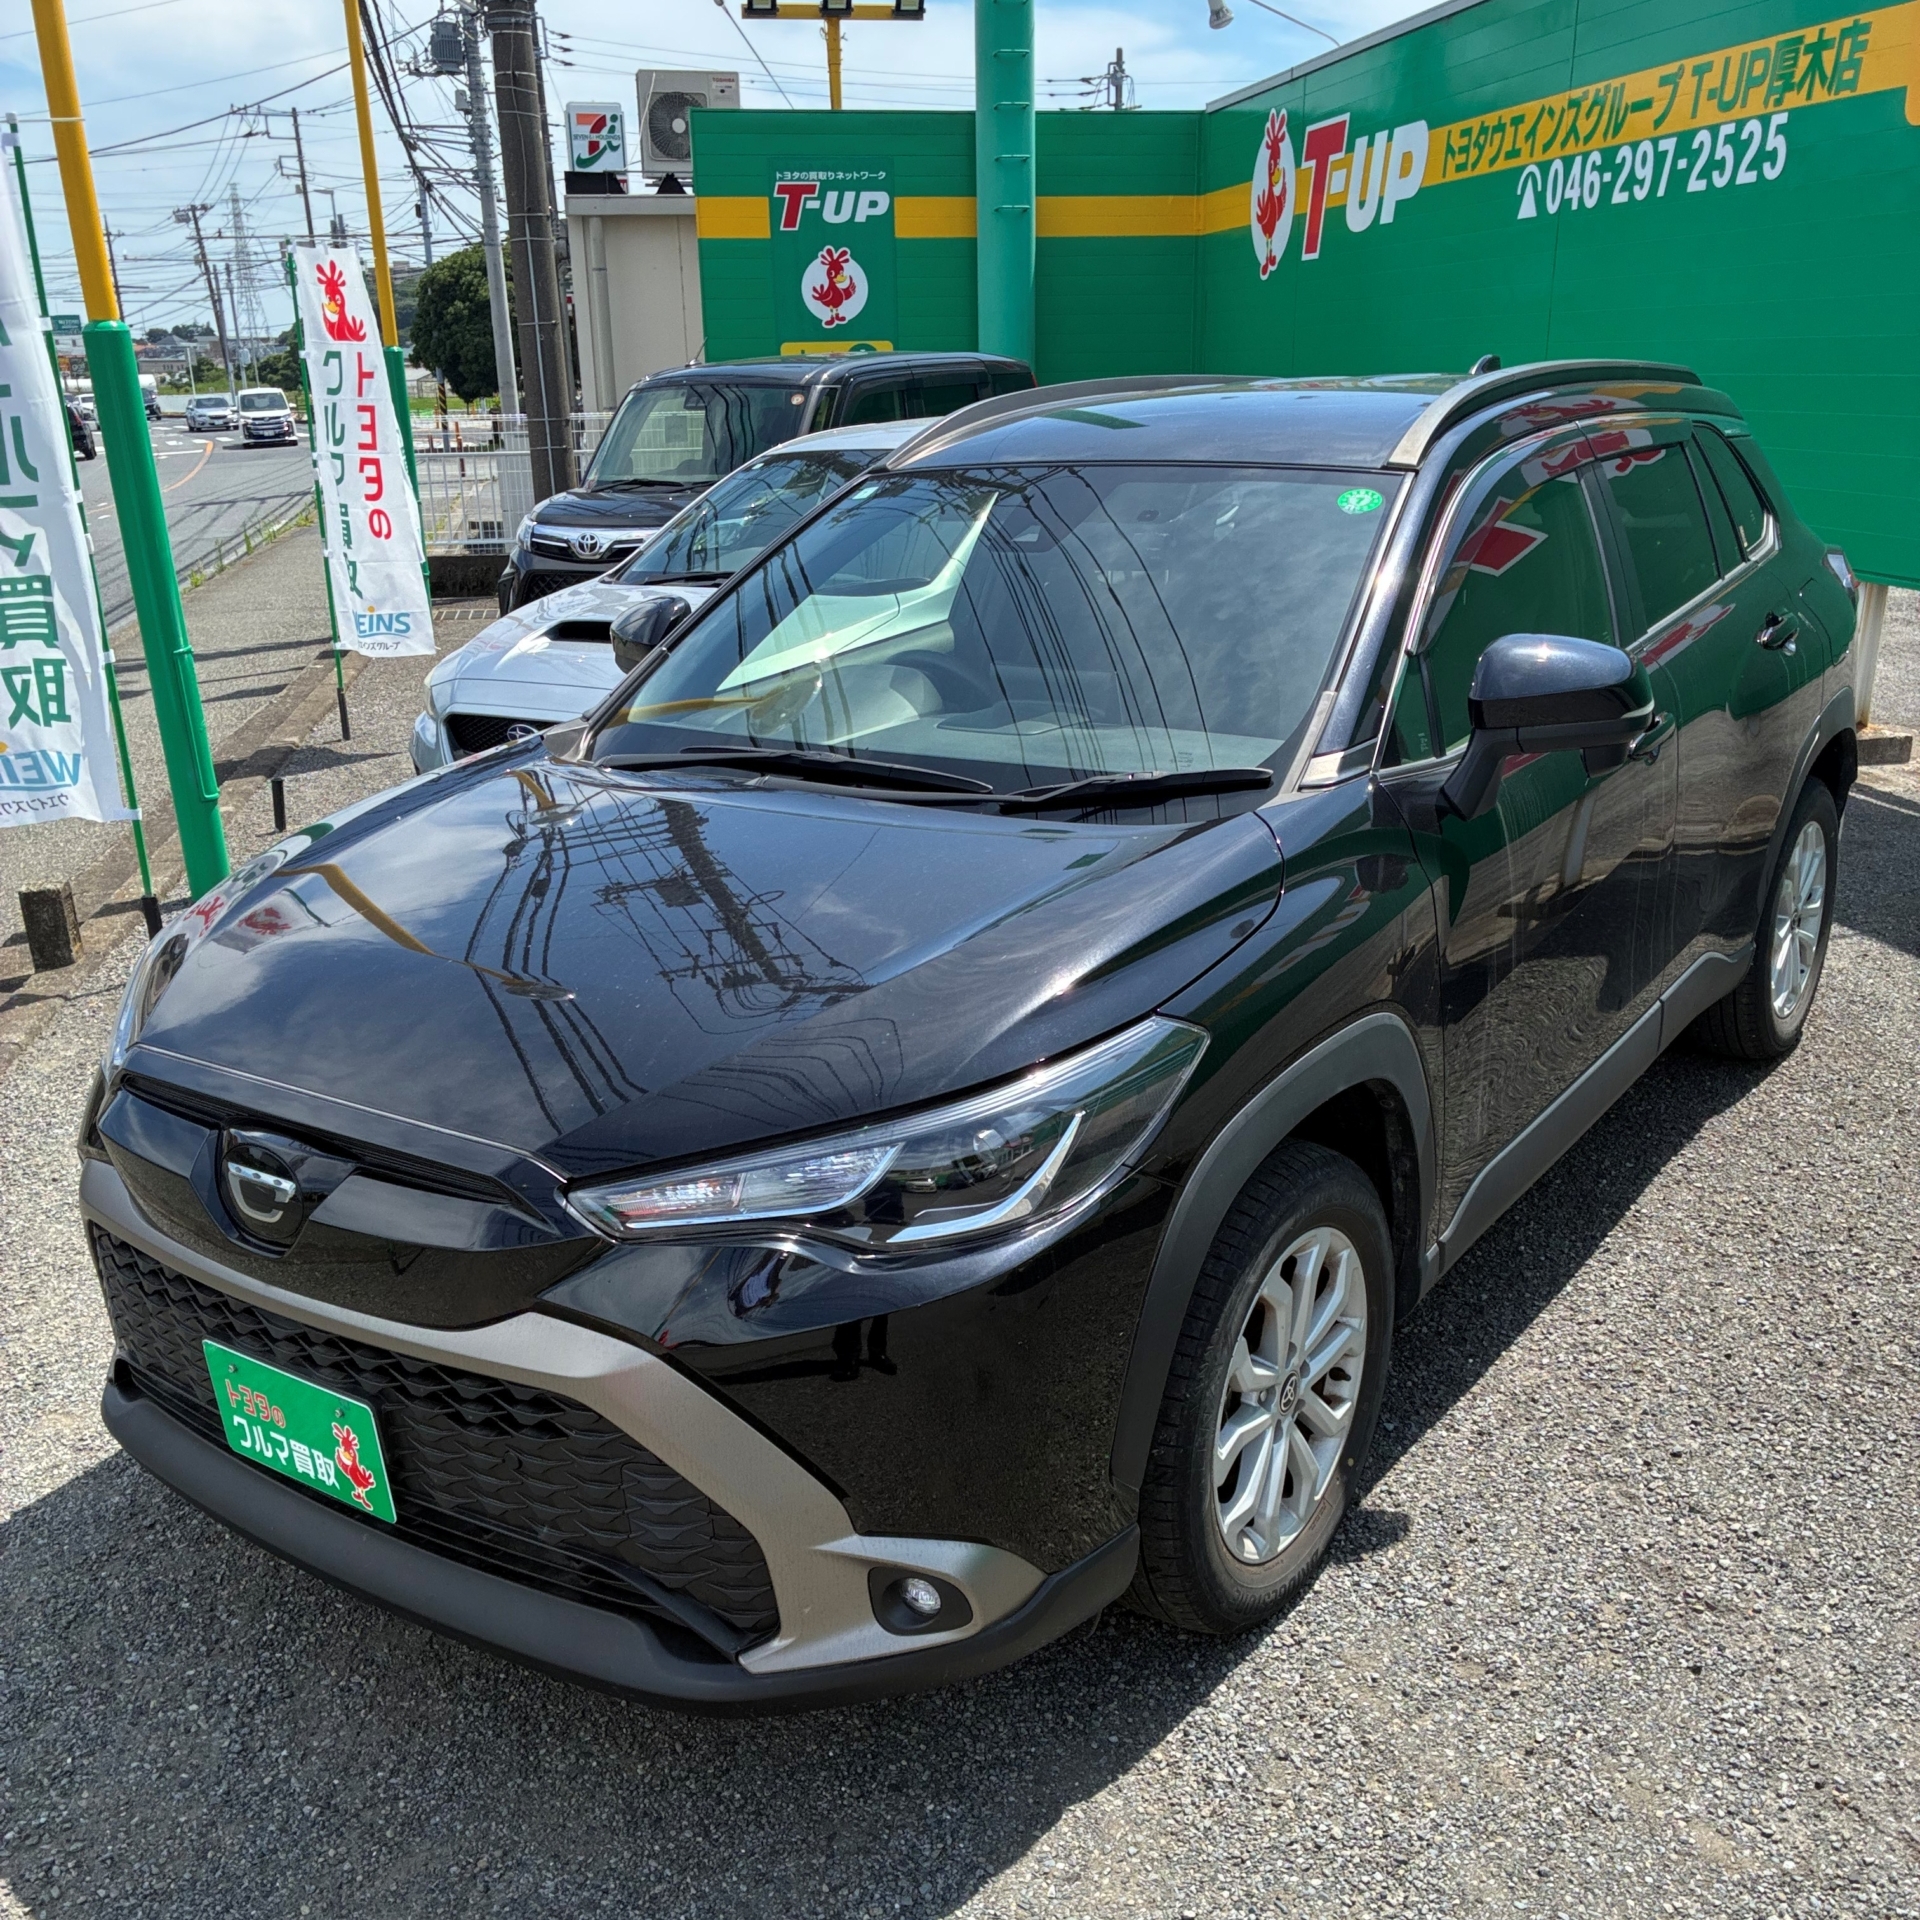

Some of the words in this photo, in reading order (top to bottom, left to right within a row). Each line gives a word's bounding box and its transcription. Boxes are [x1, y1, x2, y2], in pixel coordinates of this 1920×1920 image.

[1441, 64, 1685, 178] トヨタウエインズグループ
[1690, 19, 1873, 120] T-UP厚木店
[773, 181, 890, 231] T-UP
[776, 171, 886, 180] トヨタの買取りネットワーク
[1301, 112, 1429, 261] T-UP
[1545, 112, 1789, 214] 046-297-2525
[233, 1414, 340, 1490] クルマ買取
